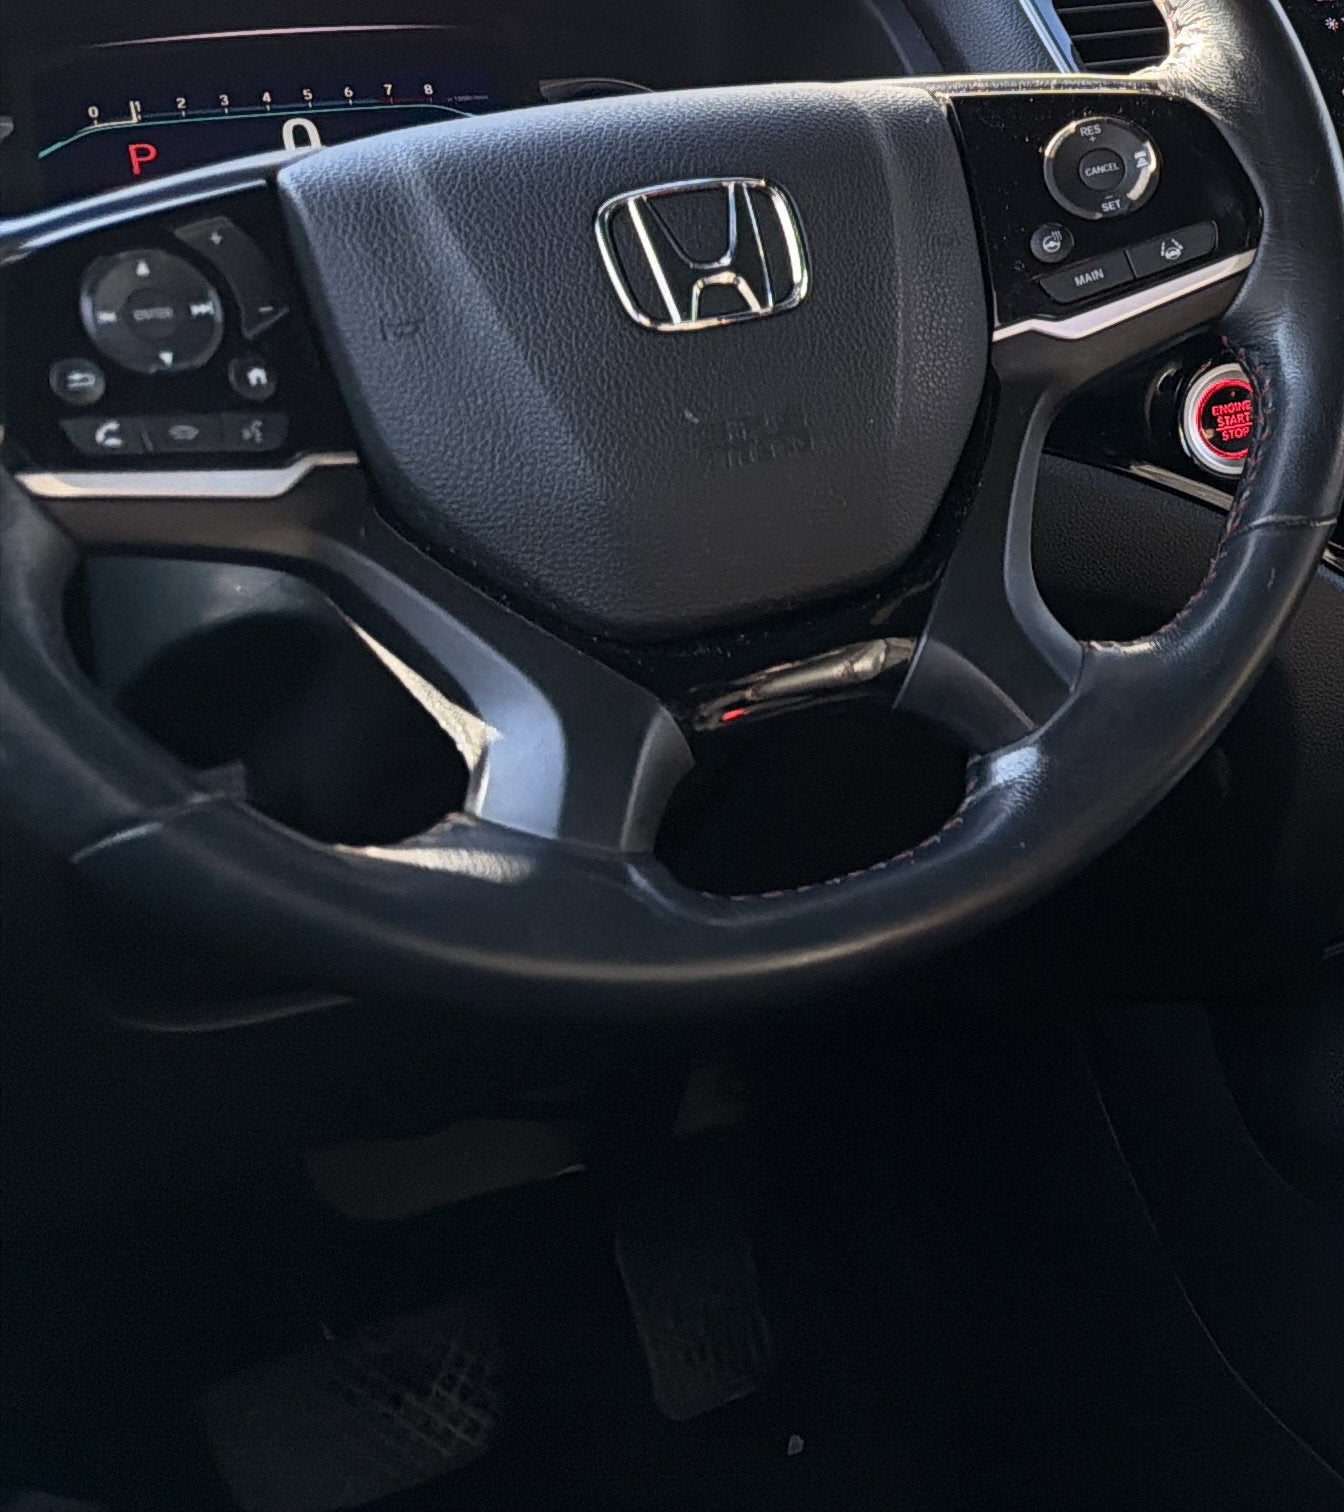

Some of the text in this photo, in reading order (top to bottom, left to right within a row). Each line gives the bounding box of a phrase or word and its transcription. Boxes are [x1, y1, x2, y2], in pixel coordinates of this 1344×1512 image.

[88, 105, 99, 120] 0
[176, 97, 188, 110] 2
[219, 94, 230, 107] 3
[262, 91, 272, 105] 4
[303, 88, 313, 101] 5
[343, 86, 354, 99] 6
[383, 83, 393, 96] 7
[423, 83, 434, 96] 8
[1079, 124, 1102, 137] RES
[127, 143, 158, 175] P
[1084, 162, 1120, 178] CANCEL
[1101, 199, 1121, 213] SET
[1074, 268, 1105, 287] MAIN
[1211, 399, 1252, 417] ENGINE
[1216, 411, 1251, 427] START
[1221, 426, 1250, 442] STOP
